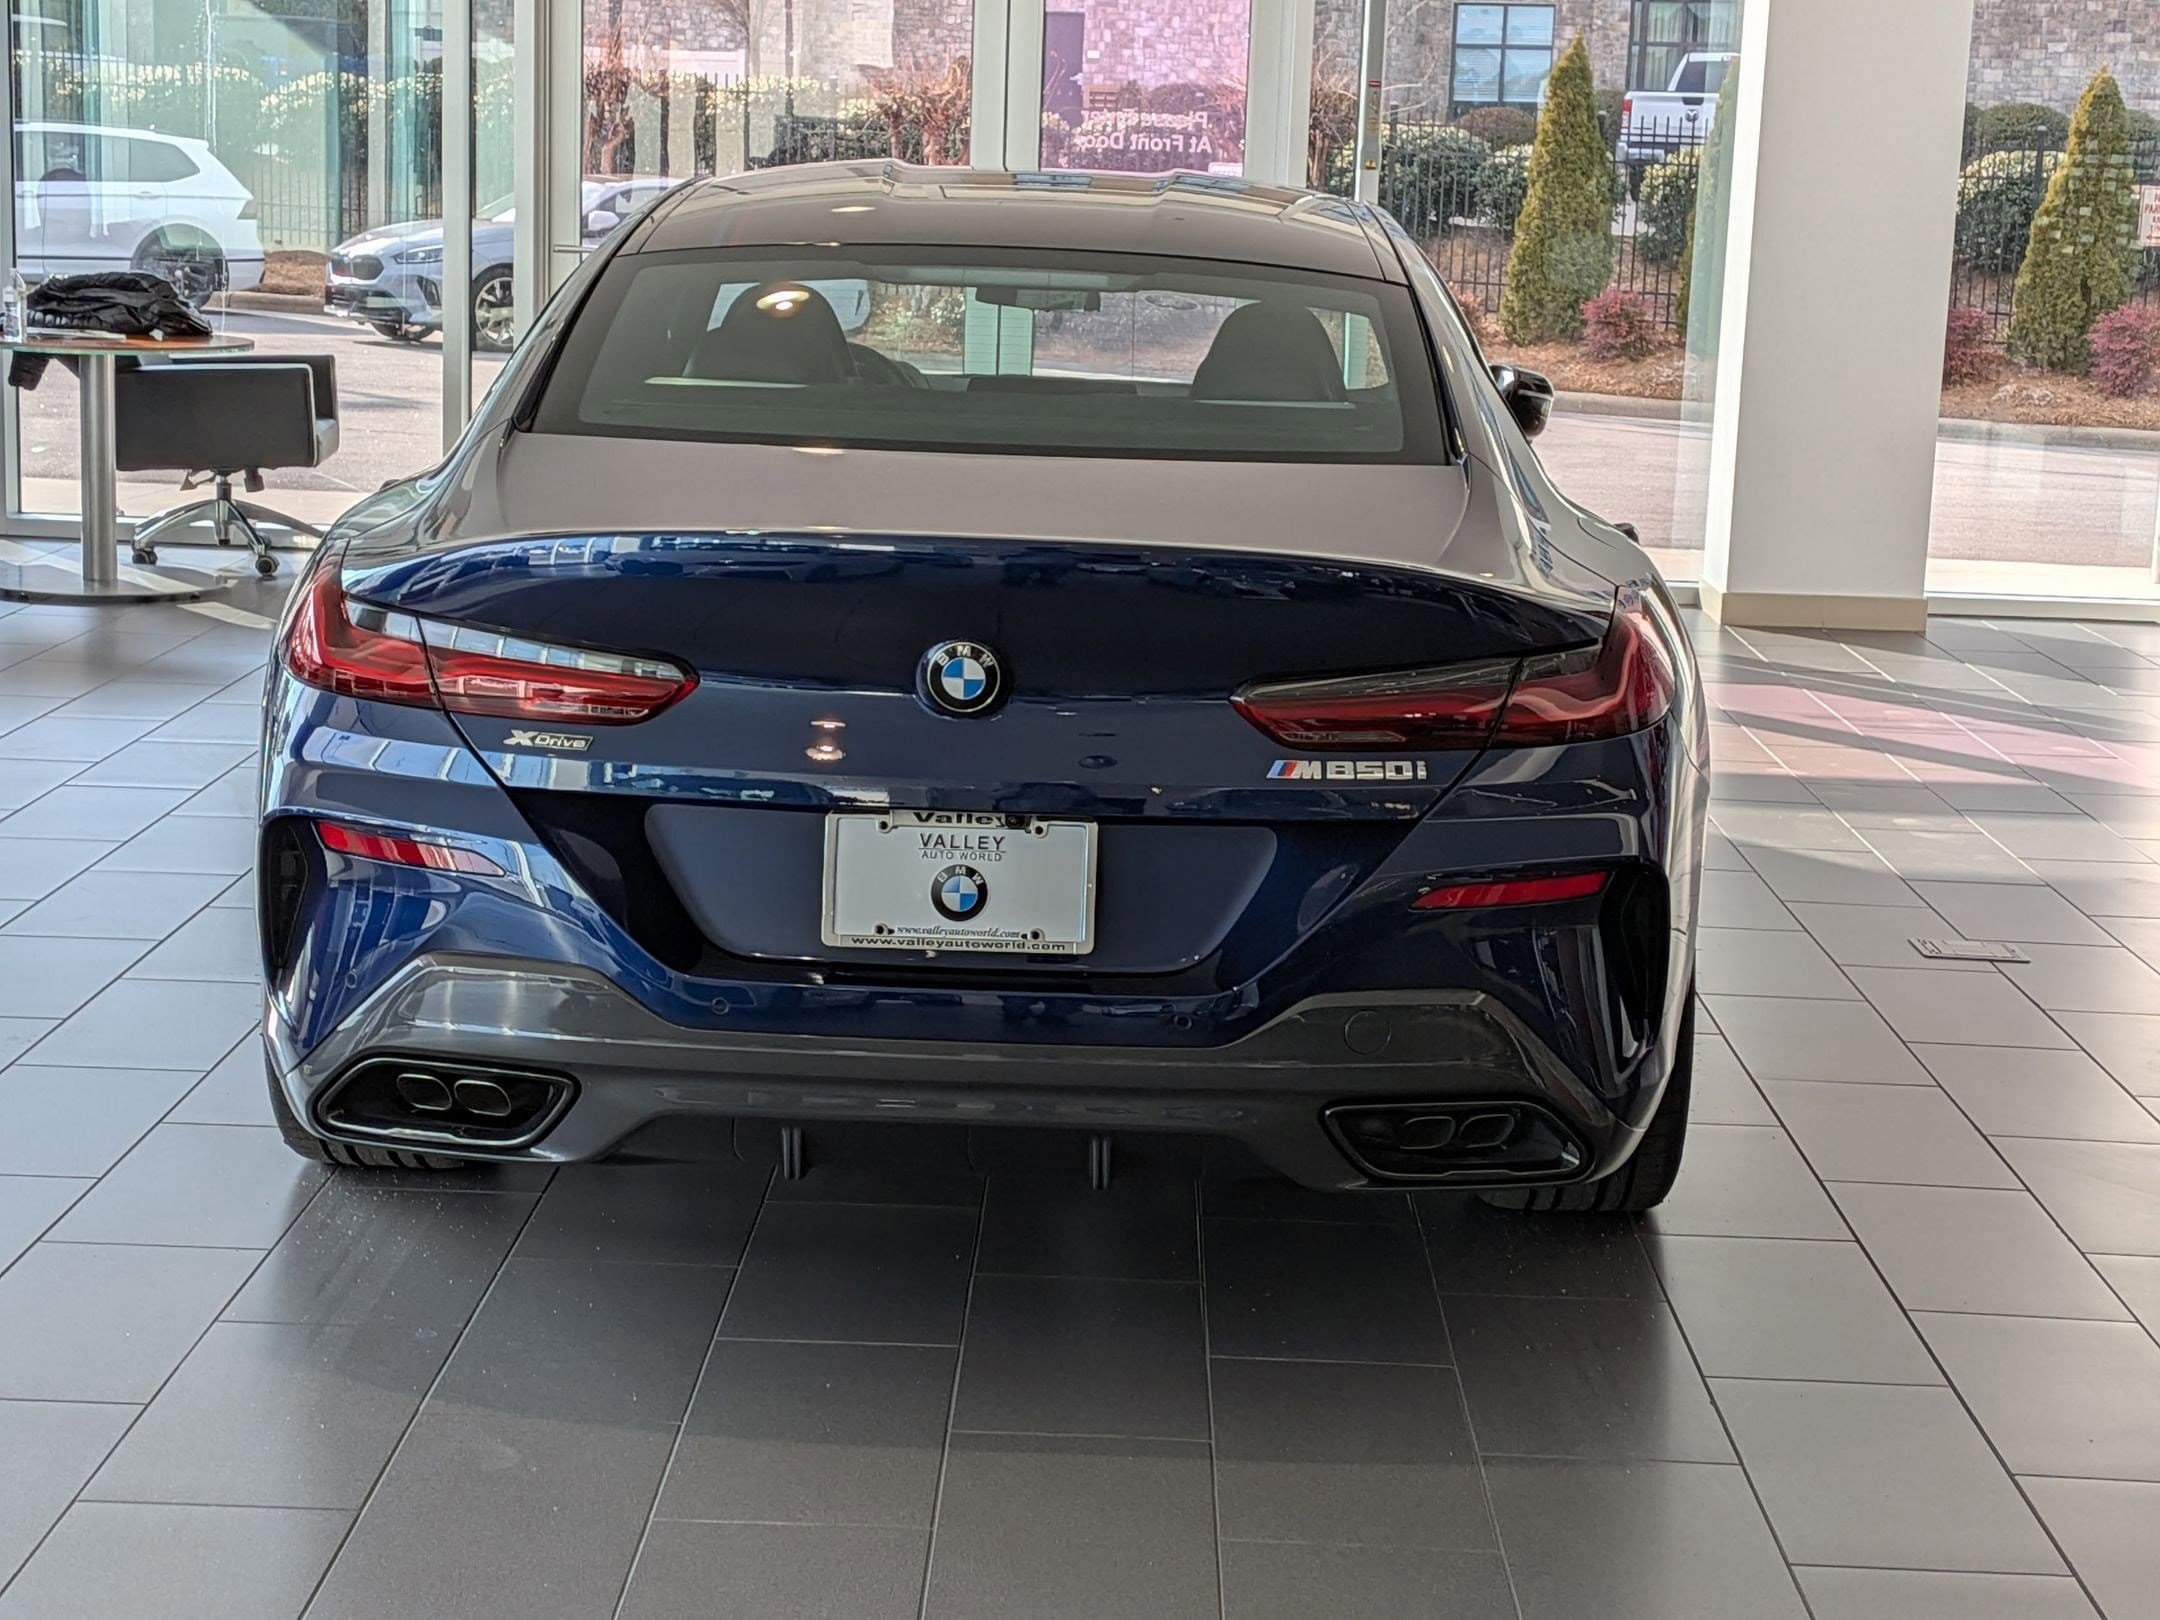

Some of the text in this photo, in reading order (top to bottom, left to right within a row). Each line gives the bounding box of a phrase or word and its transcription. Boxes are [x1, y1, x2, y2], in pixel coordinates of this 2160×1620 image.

[937, 645, 994, 668] BMW
[920, 833, 1006, 851] VALLEY
[921, 851, 1002, 862] AUTO WORLD
[937, 865, 984, 885] BMW
[896, 925, 1020, 939] www.valleyautoworld.com
[851, 936, 1066, 951] www.valleyautoworld.com
